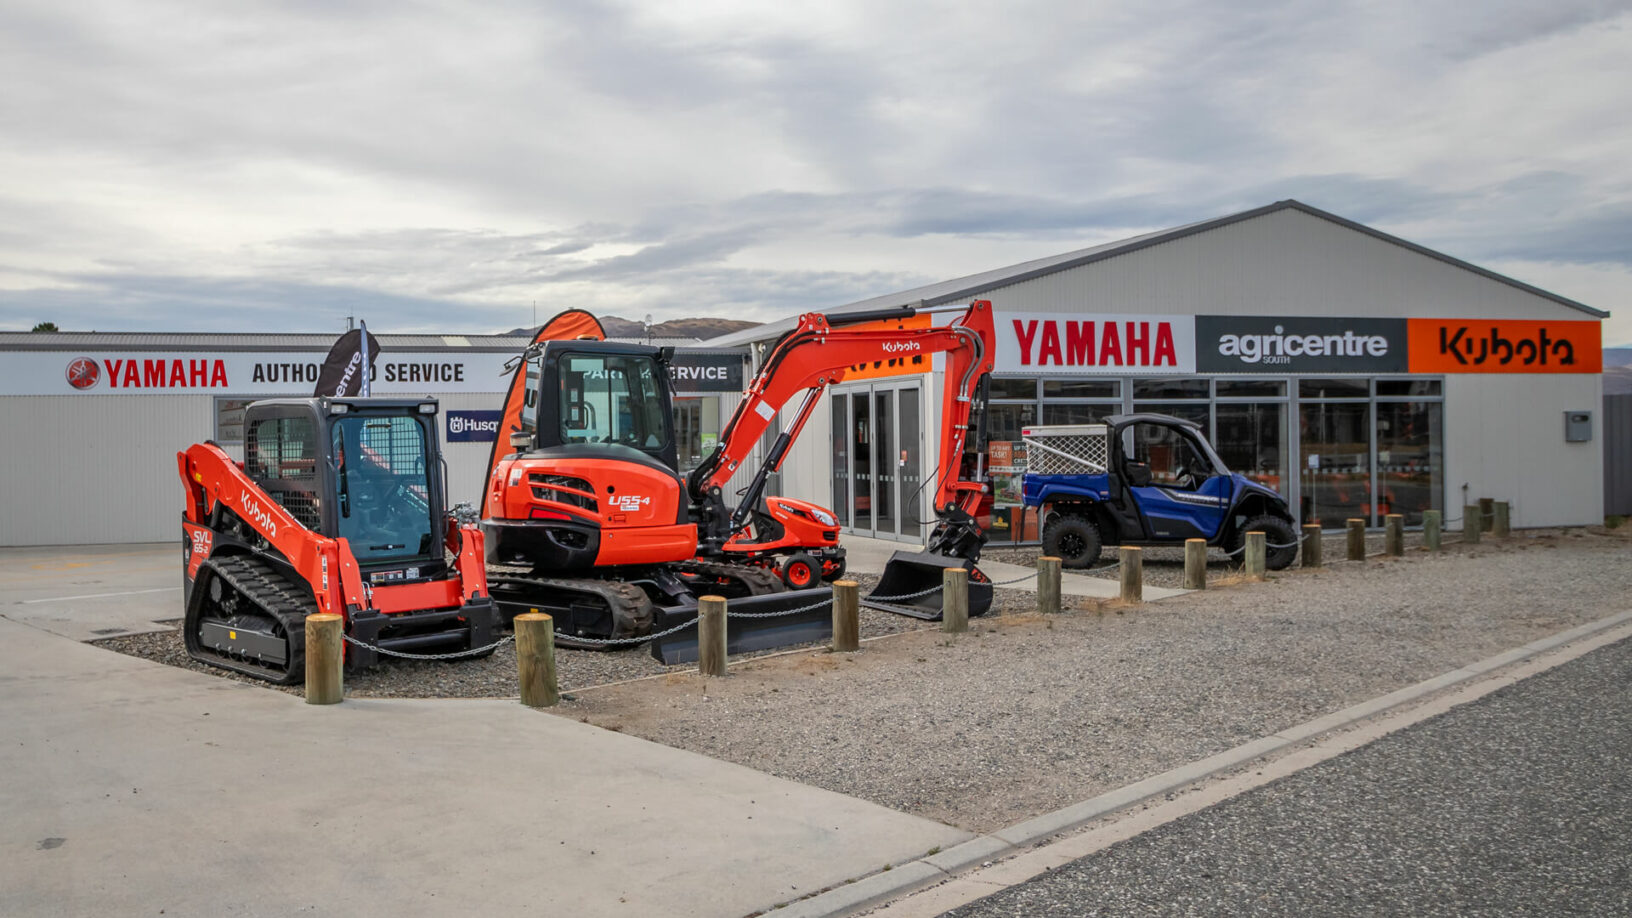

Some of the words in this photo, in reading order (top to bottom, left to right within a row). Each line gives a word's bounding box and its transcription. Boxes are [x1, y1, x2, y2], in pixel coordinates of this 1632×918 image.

[882, 340, 921, 353] Kubota
[1012, 319, 1177, 366] YAMAHA
[1218, 325, 1388, 363] agricentre
[1440, 326, 1575, 365] Kubota
[1263, 356, 1291, 364] SOUTH
[104, 359, 229, 388] YAMAHA
[335, 351, 362, 398] entre
[385, 363, 464, 383] SERVICE
[669, 366, 728, 380] ERVICE
[464, 418, 498, 434] Husq
[608, 495, 651, 506] U55-4
[240, 488, 276, 538] Kubota
[193, 530, 212, 544] SVL
[193, 543, 209, 554] 65-2
